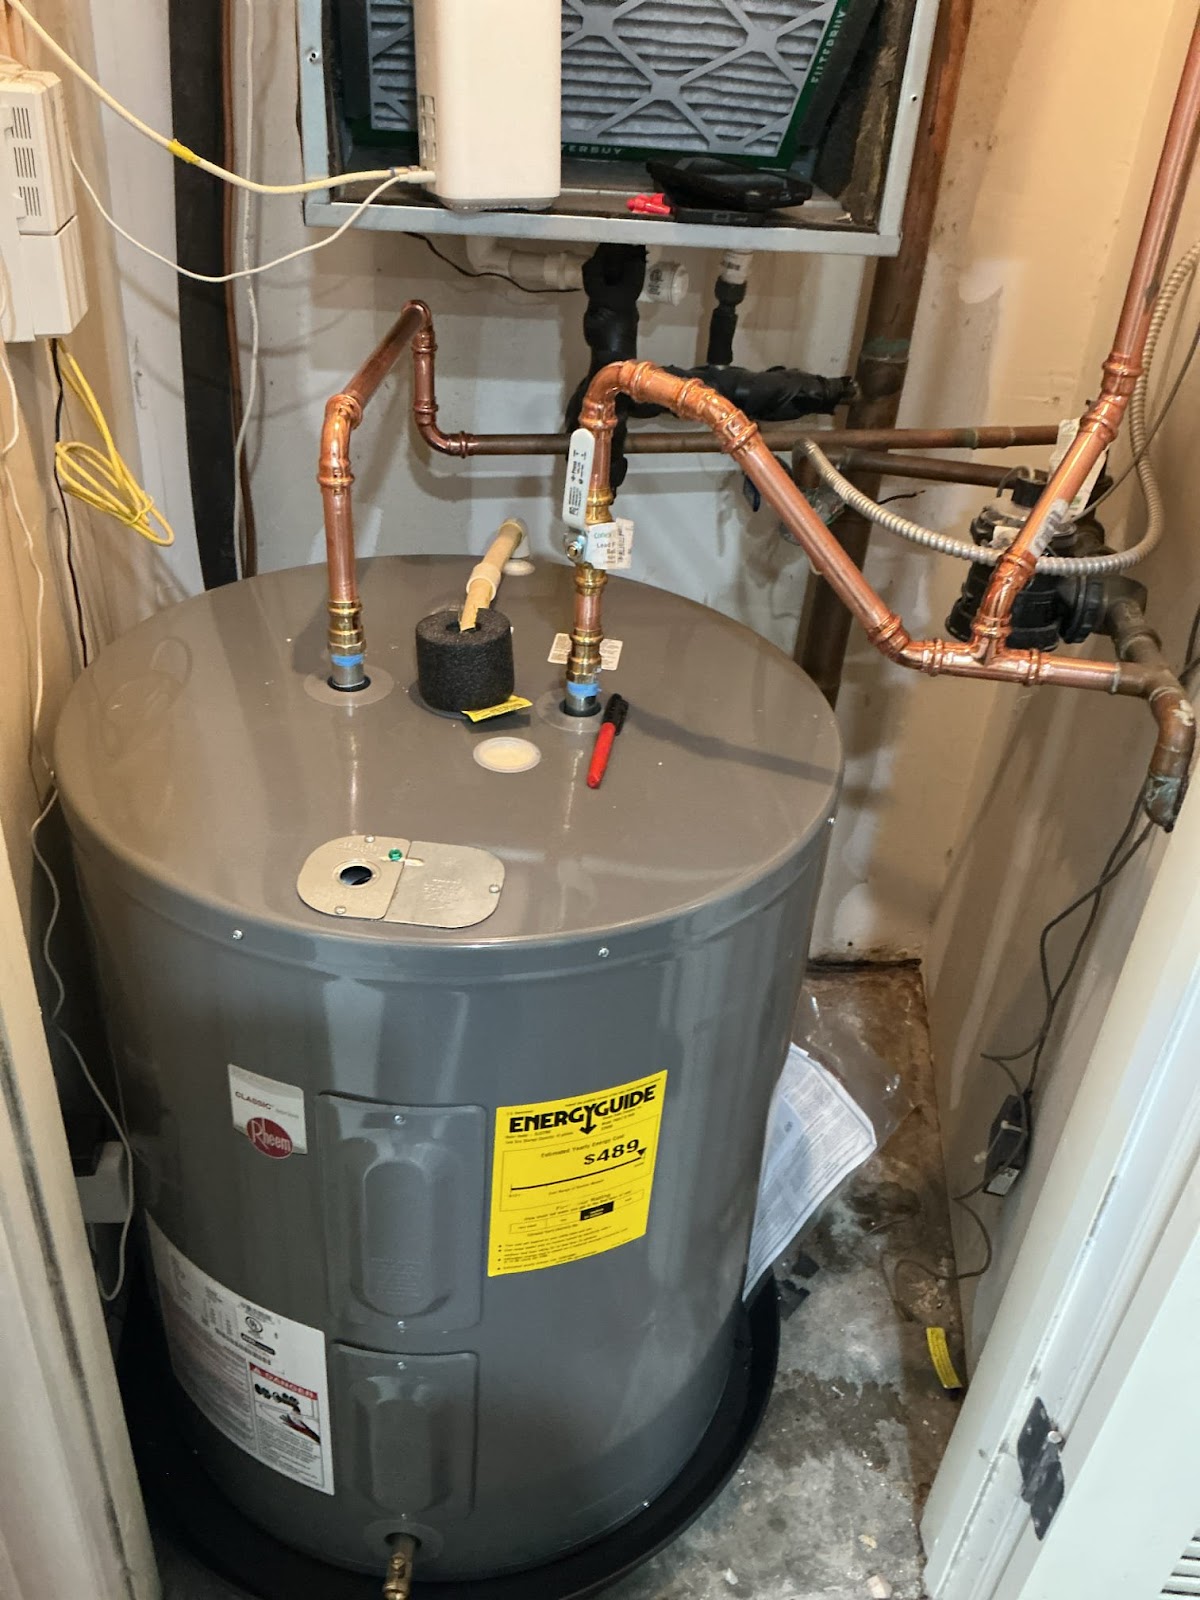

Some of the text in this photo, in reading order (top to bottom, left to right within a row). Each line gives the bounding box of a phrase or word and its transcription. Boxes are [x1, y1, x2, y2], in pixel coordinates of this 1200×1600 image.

[811, 8, 847, 83] FILTERBUY
[235, 1091, 272, 1110] CLASSIC
[509, 1084, 658, 1133] ENERGYGUIDE
[250, 1117, 292, 1154] Rheem
